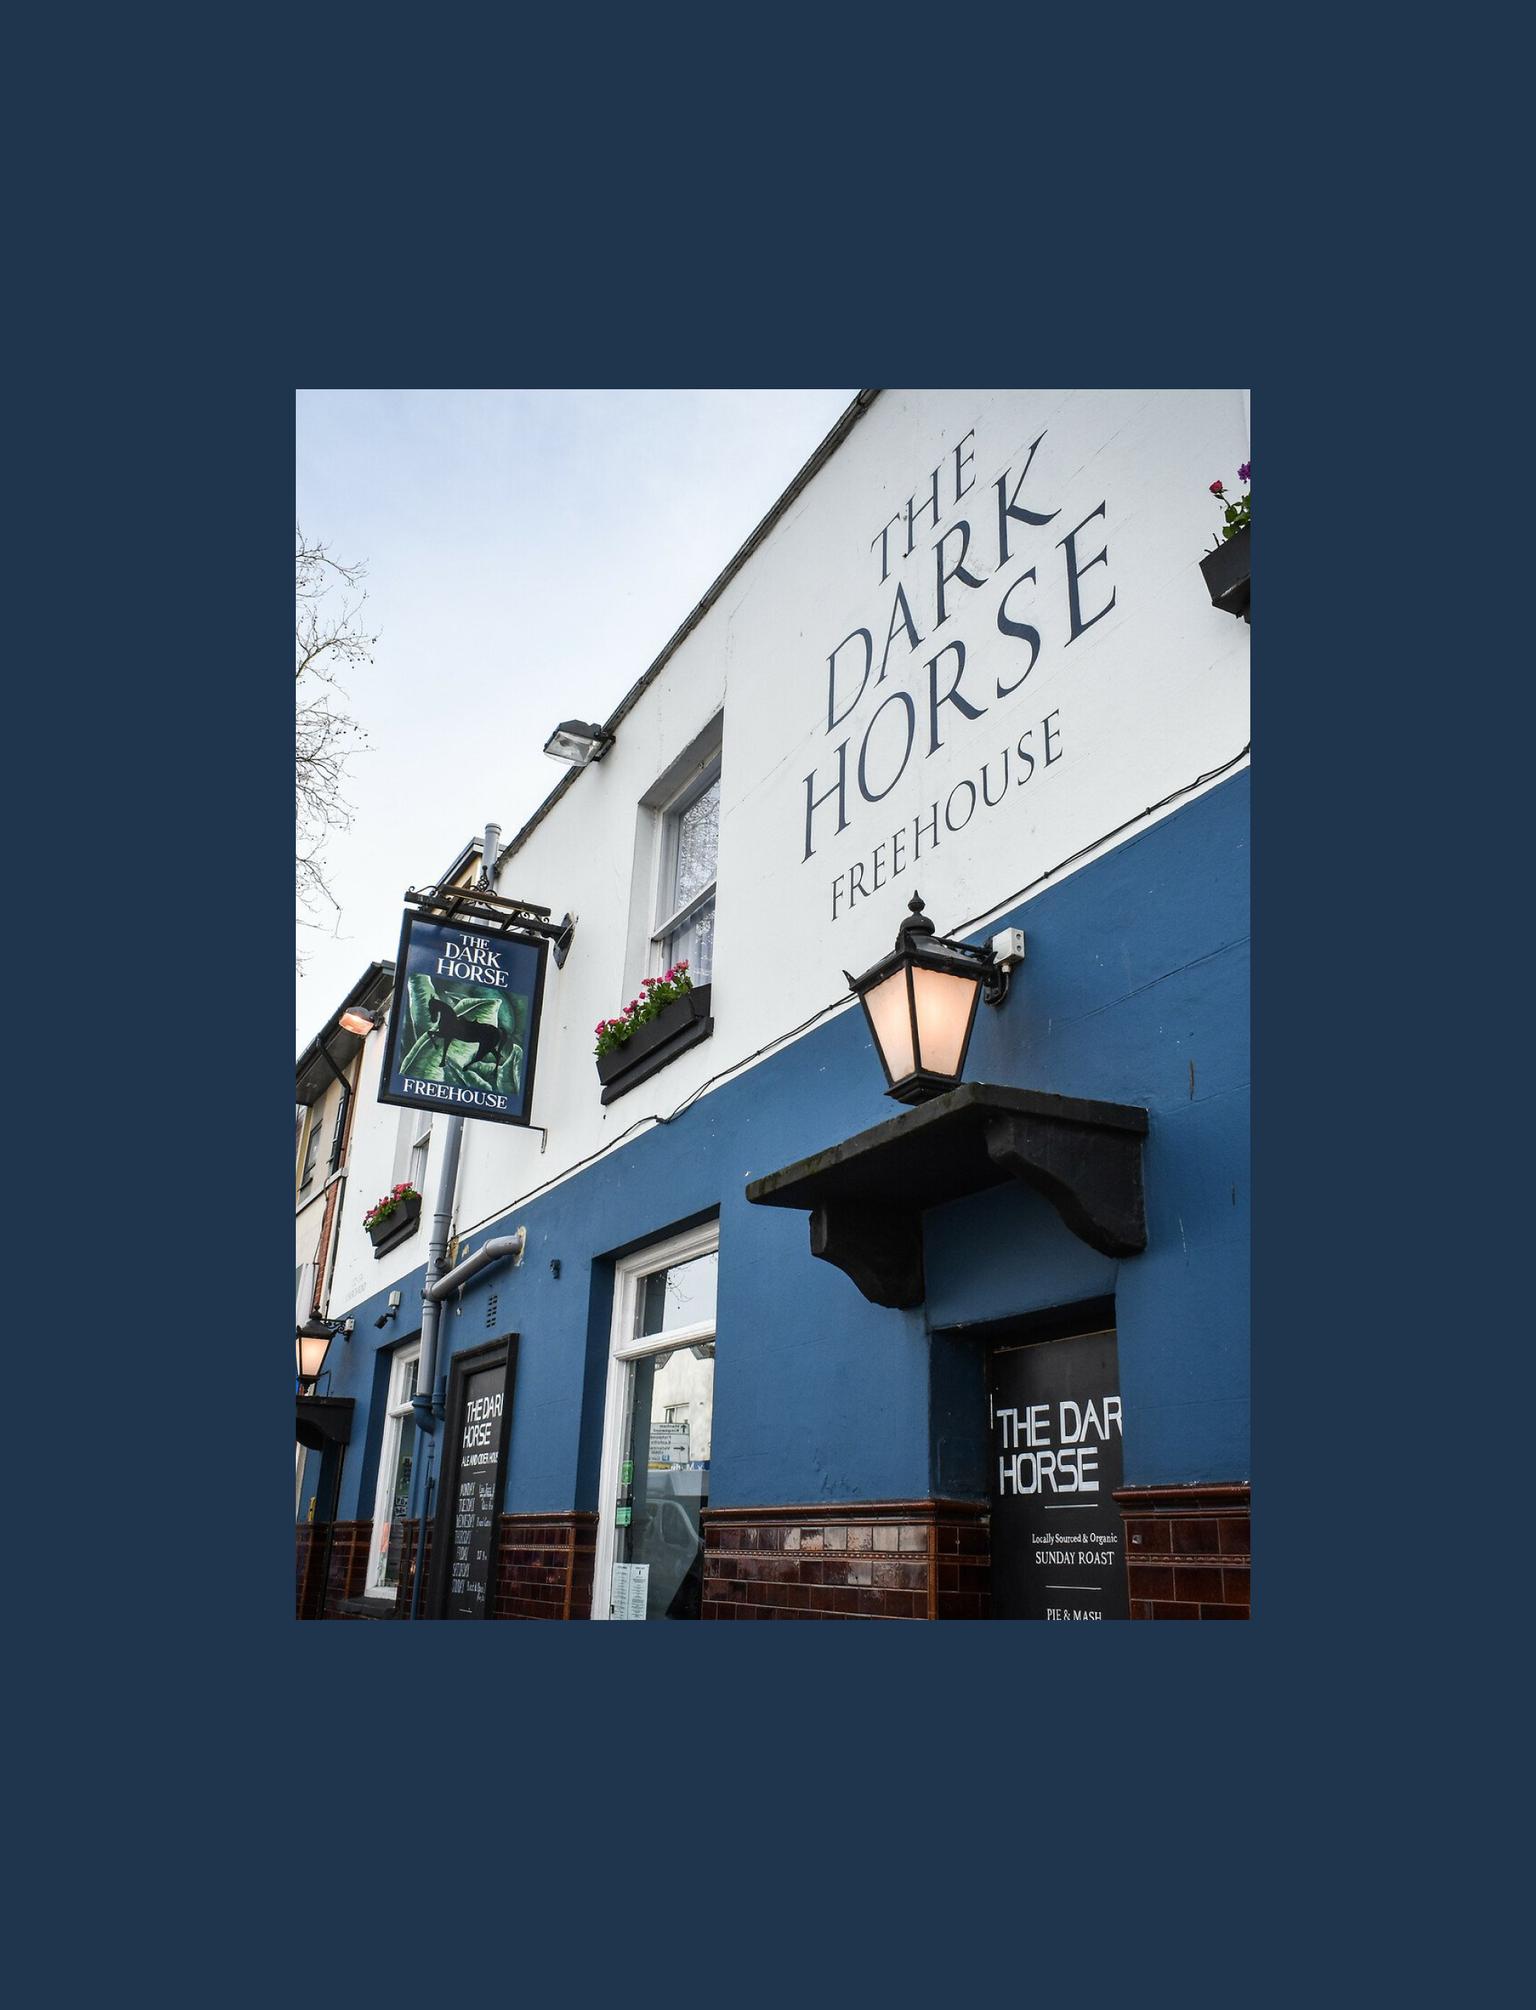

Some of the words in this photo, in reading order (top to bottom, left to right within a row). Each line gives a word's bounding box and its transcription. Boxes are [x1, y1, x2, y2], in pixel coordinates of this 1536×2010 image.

[871, 428, 976, 586] THE
[825, 430, 1061, 735] DARK
[801, 500, 1115, 864] HORSE
[831, 709, 1063, 921] FREEHOUSE
[445, 942, 502, 969] DARK
[460, 933, 490, 950] THE
[436, 958, 509, 988] HORSE
[403, 1078, 508, 1109] FREEHOUSE
[467, 1398, 483, 1423] THE
[997, 1404, 1050, 1448] THE
[1059, 1396, 1123, 1444] DAR
[462, 1422, 492, 1449] HORSE
[1000, 1446, 1099, 1495] HORSE
[1031, 1533, 1055, 1546] Locally
[1055, 1532, 1082, 1544] Sourced
[1082, 1533, 1089, 1543] &
[1090, 1532, 1118, 1546] Organic
[1035, 1551, 1076, 1565] SUNDAY
[1078, 1551, 1115, 1566] ROAST
[1047, 1608, 1062, 1620] PIE
[1063, 1608, 1071, 1620] &
[1073, 1610, 1102, 1620] MASH
